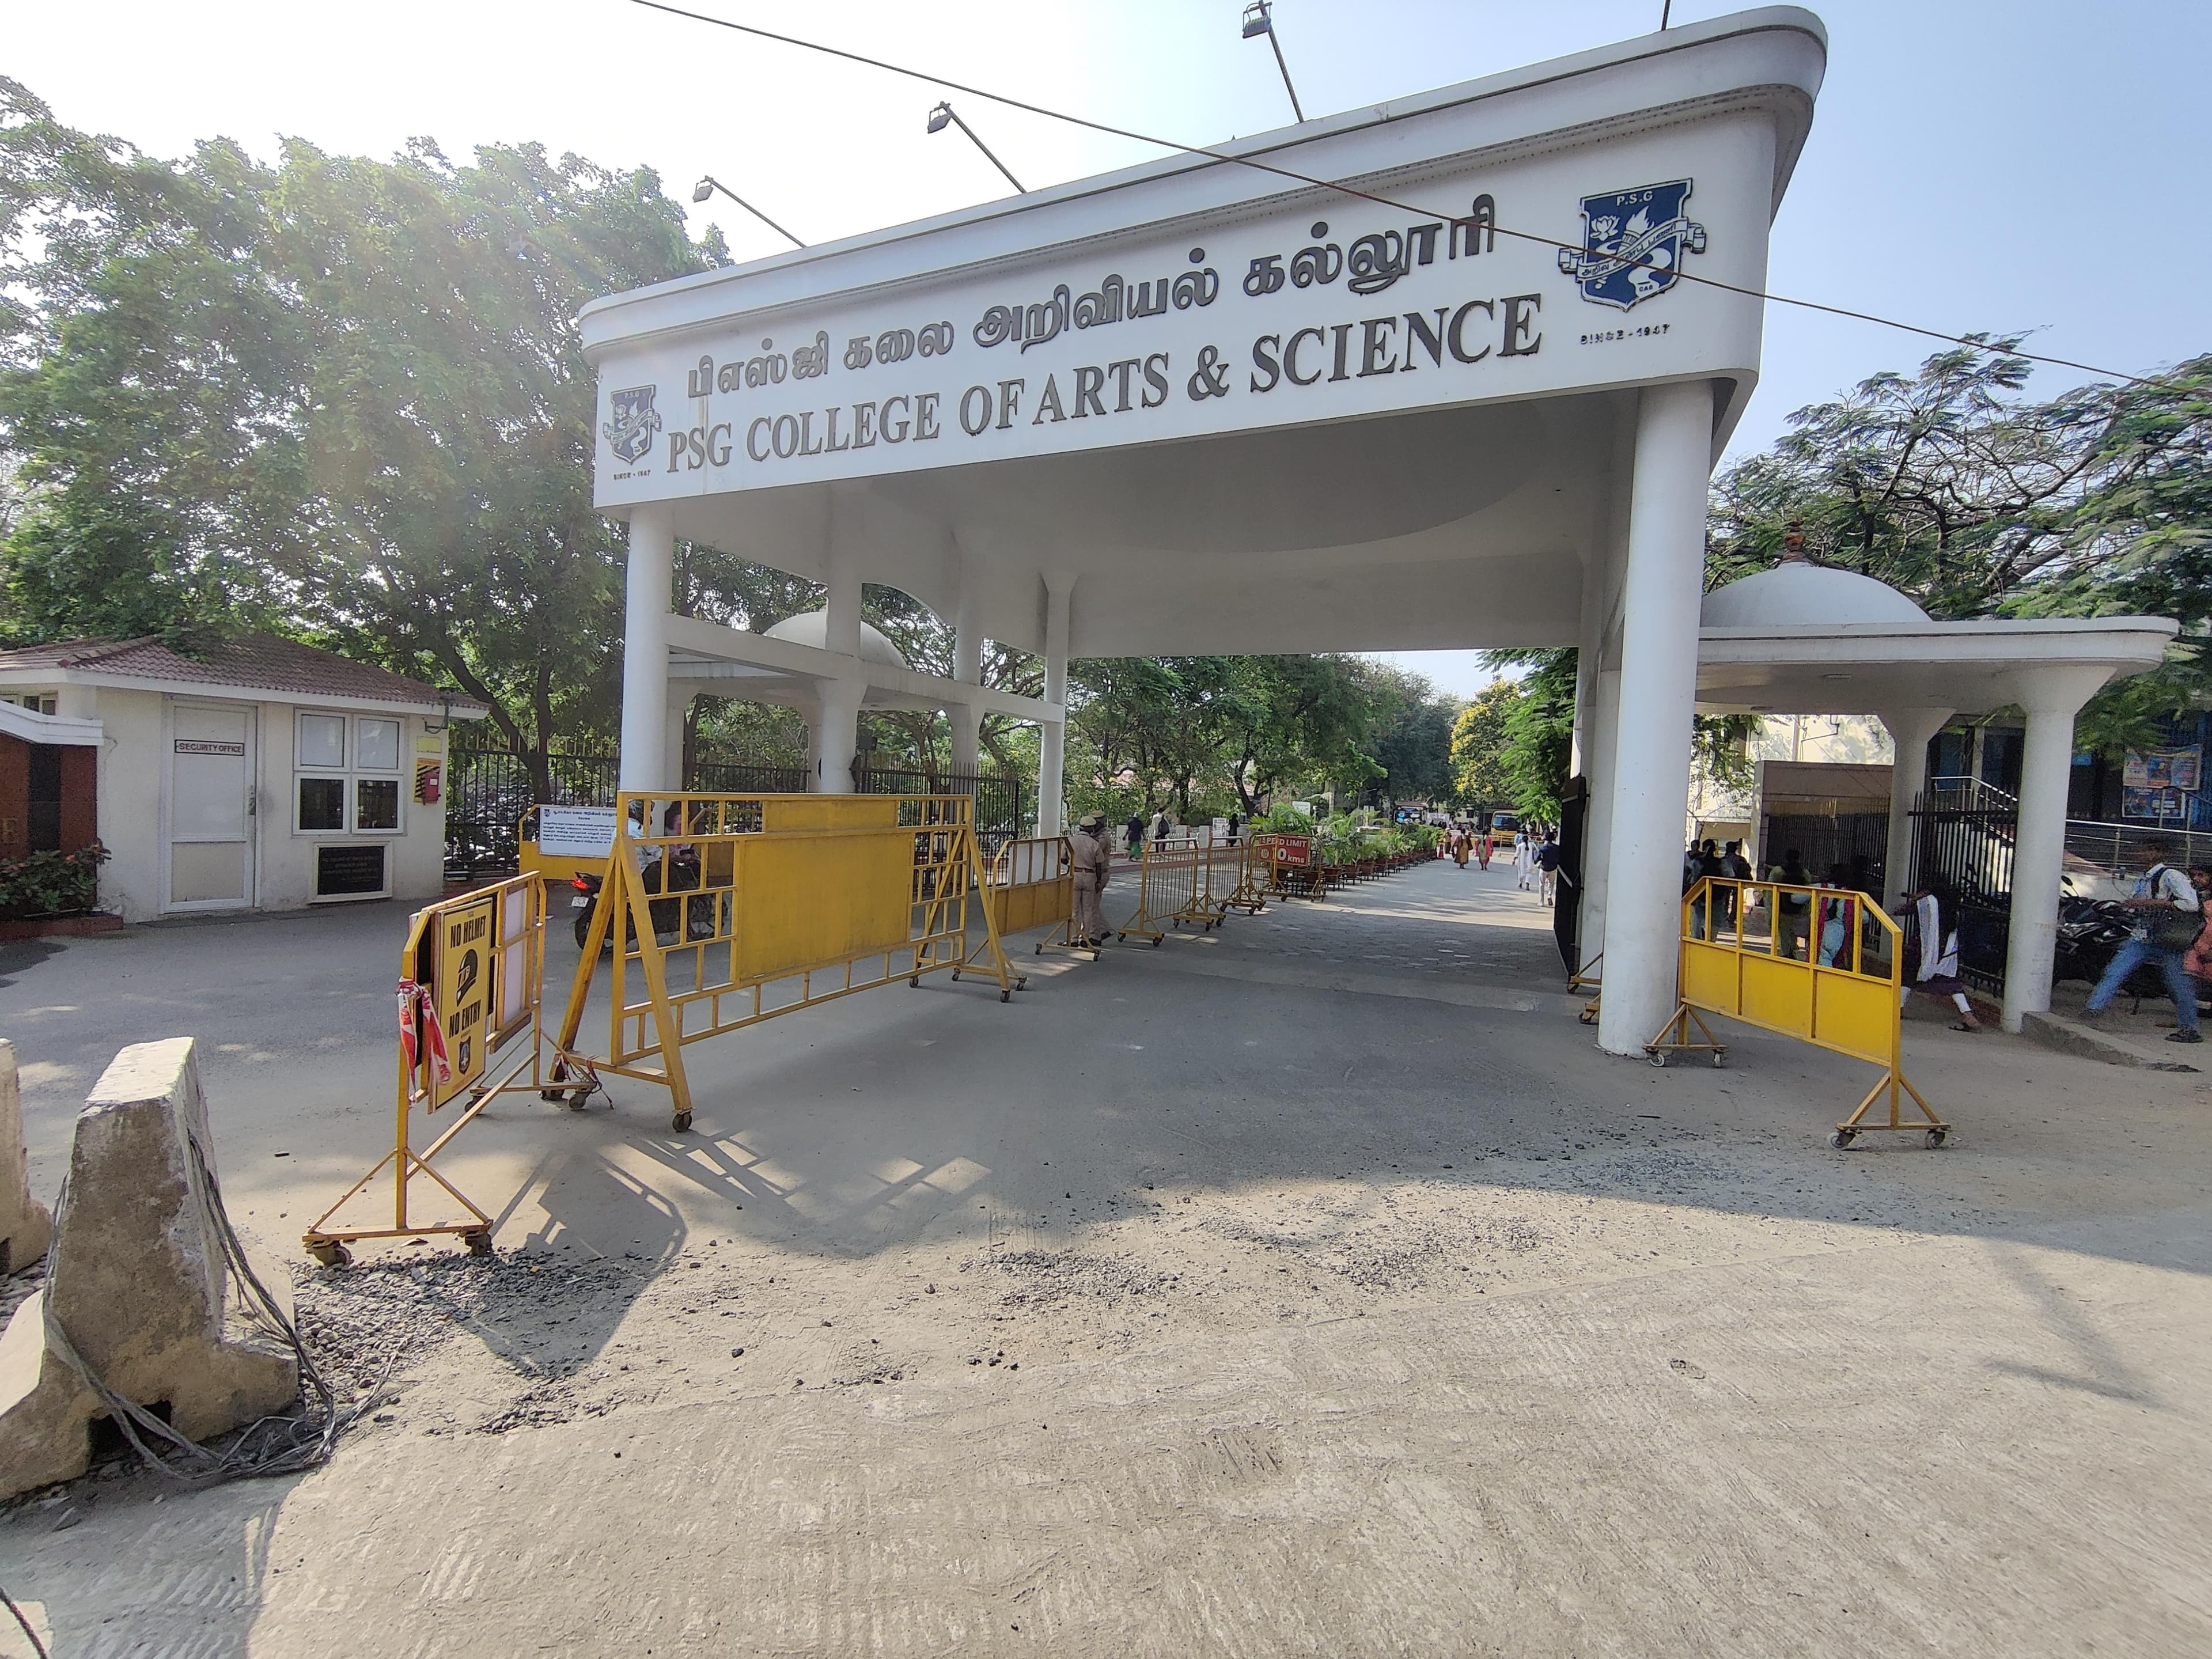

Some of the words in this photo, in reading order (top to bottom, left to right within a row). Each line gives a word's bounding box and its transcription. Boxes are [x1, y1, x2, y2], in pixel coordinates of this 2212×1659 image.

[1616, 190, 1653, 206] P.S.G
[843, 320, 954, 370] கலை
[972, 248, 1219, 354] அறிவியல்
[1243, 194, 1495, 296] கல்லூரி
[666, 422, 733, 474] PSG
[747, 392, 941, 463] COLLEGE
[959, 377, 1025, 436] OF
[1032, 351, 1169, 425] ARTS
[1187, 344, 1230, 402] &
[1250, 292, 1543, 393] SCIENCE
[179, 742, 218, 752] SECURITY
[218, 745, 243, 753] OFFICE
[1262, 836, 1285, 846] SPED
[1286, 839, 1307, 848] LIMIT
[1287, 854, 1305, 863] kms
[450, 923, 461, 949] NO
[463, 915, 487, 945] HELMET
[449, 1012, 460, 1039] NO
[461, 999, 481, 1032] ENTRY
